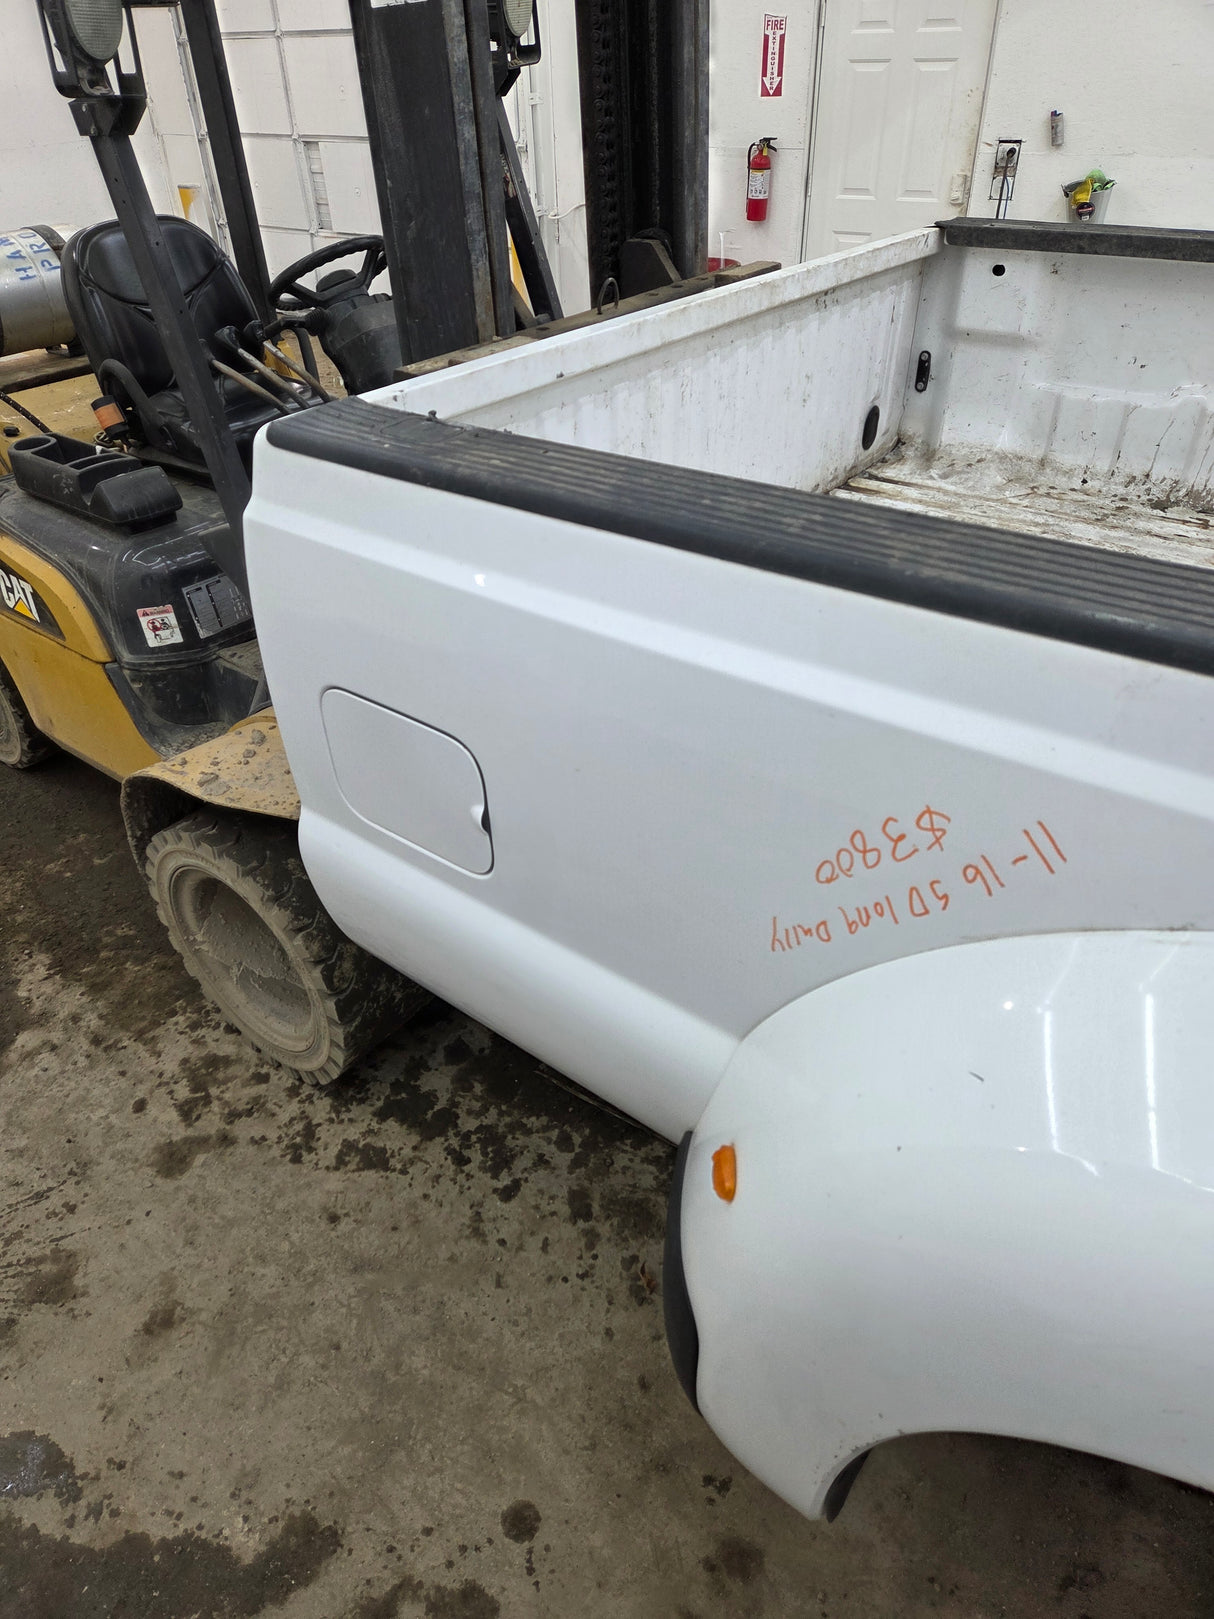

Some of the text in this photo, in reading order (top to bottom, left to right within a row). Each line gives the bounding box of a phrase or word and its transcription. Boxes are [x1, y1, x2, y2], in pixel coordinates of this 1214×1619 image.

[766, 19, 784, 30] FIRE
[769, 31, 777, 90] EXTINGUISHER
[0, 568, 41, 623] CAT
[815, 805, 951, 884] $3800
[962, 821, 1067, 896] 11-16
[838, 895, 898, 935] long
